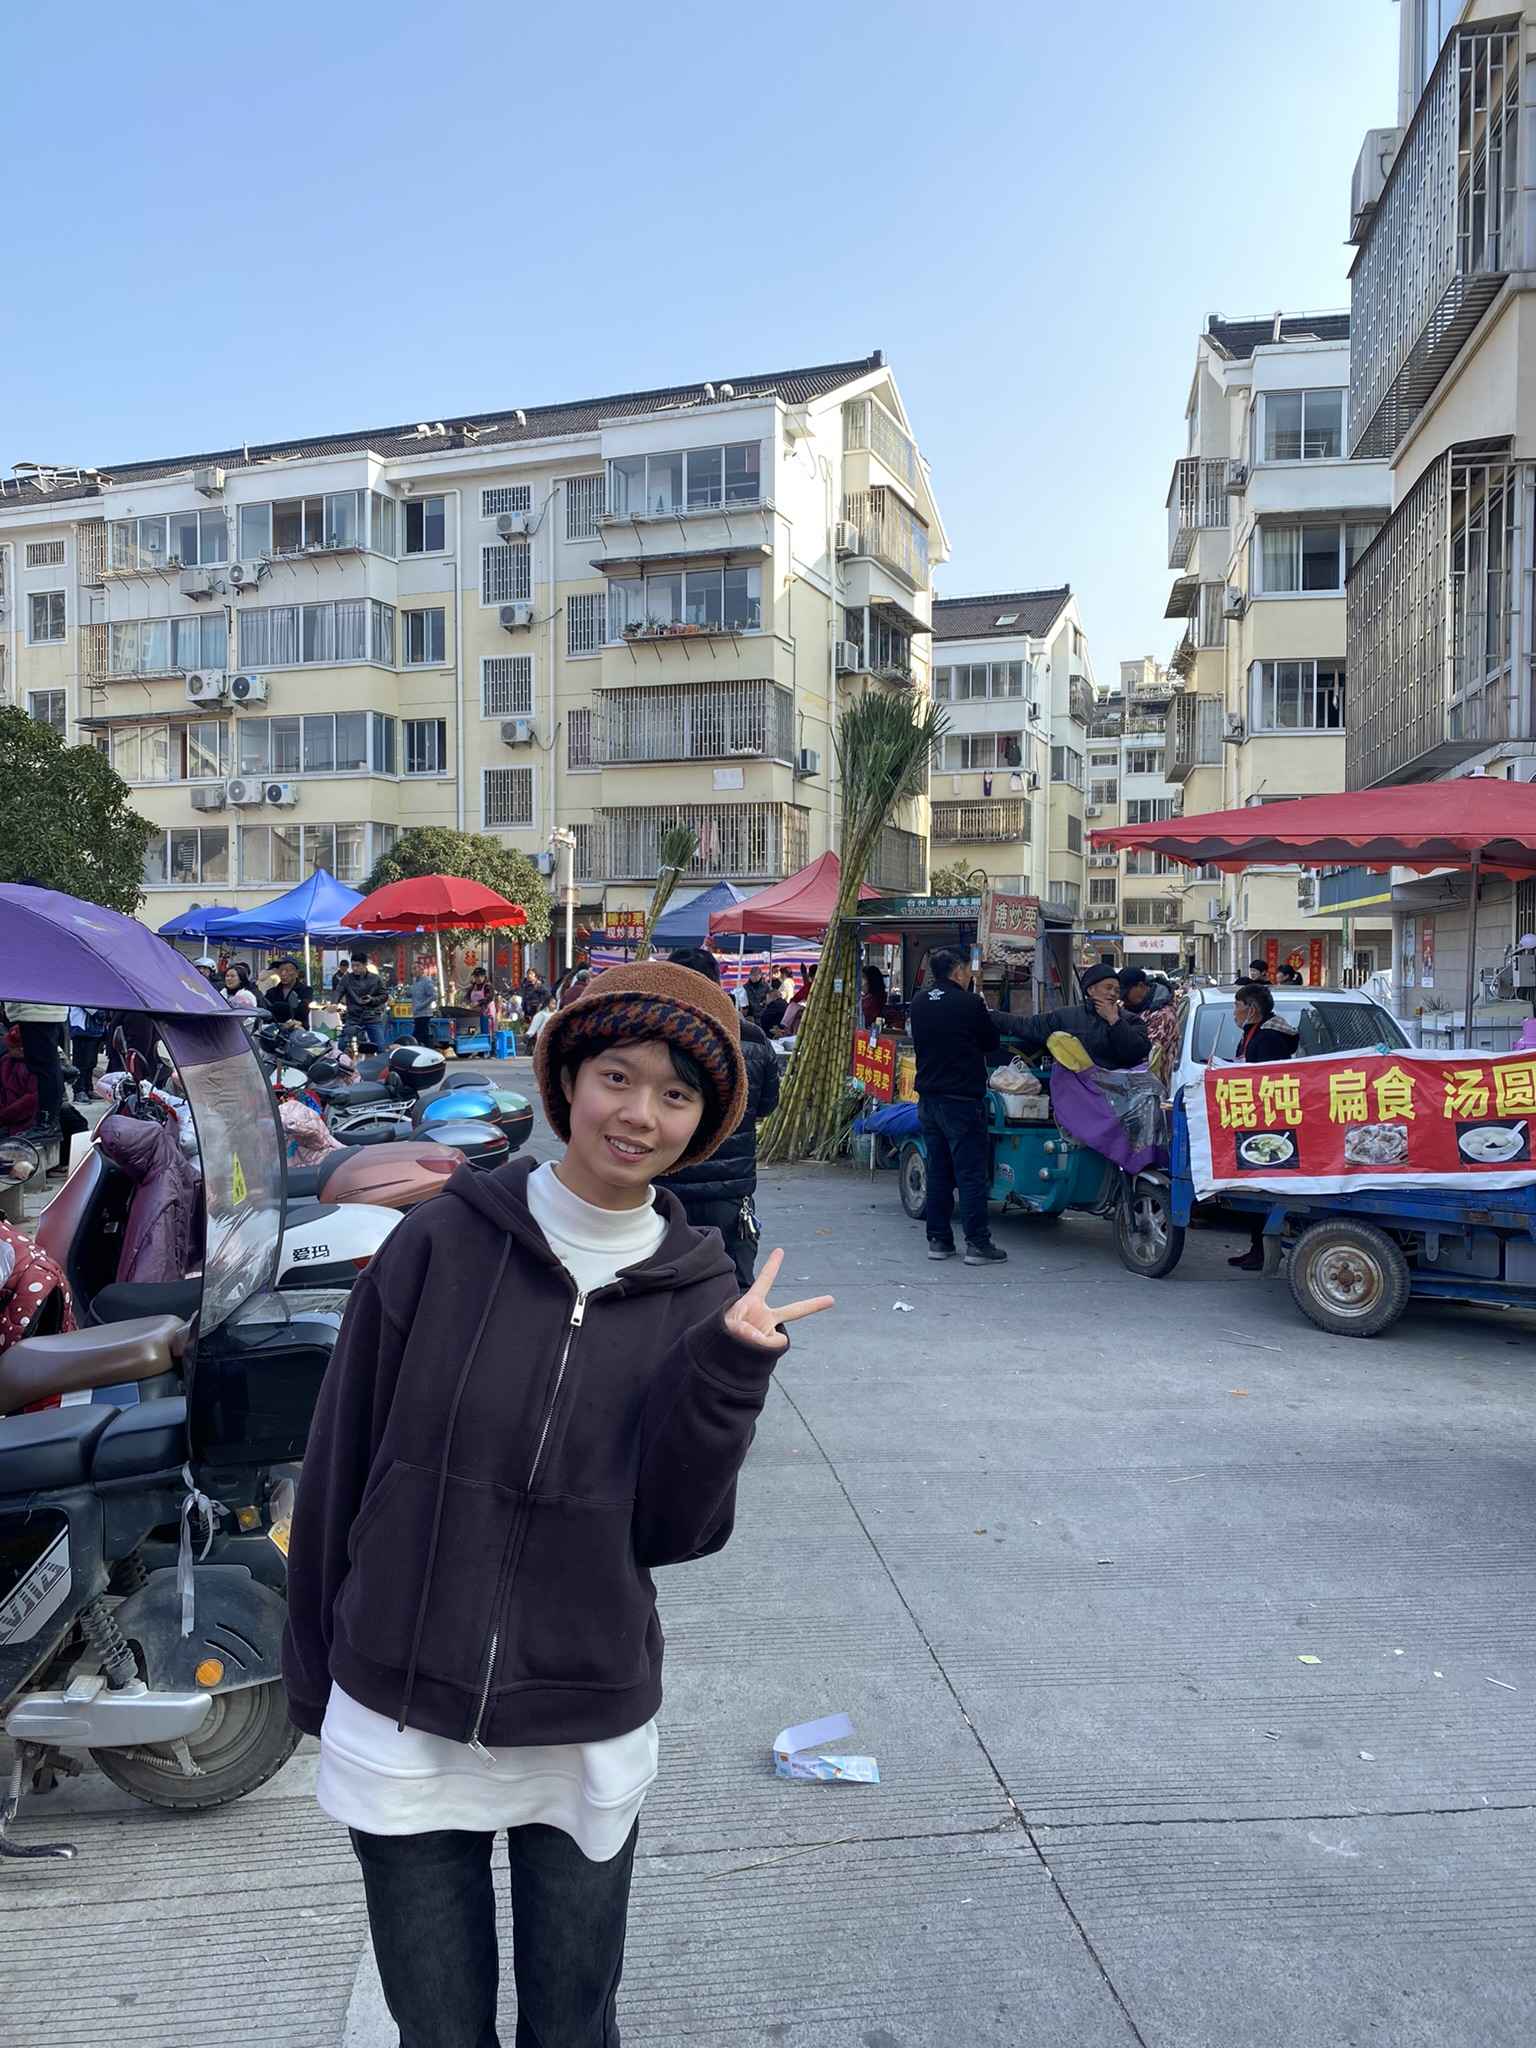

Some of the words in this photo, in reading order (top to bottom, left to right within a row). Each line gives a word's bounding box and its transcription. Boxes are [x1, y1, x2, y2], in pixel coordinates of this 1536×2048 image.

[1215, 1073, 1303, 1129] 馄饨
[1328, 1065, 1417, 1124] 扁食
[1442, 1060, 1536, 1119] 汤圆
[292, 1244, 330, 1263] 爱玛
